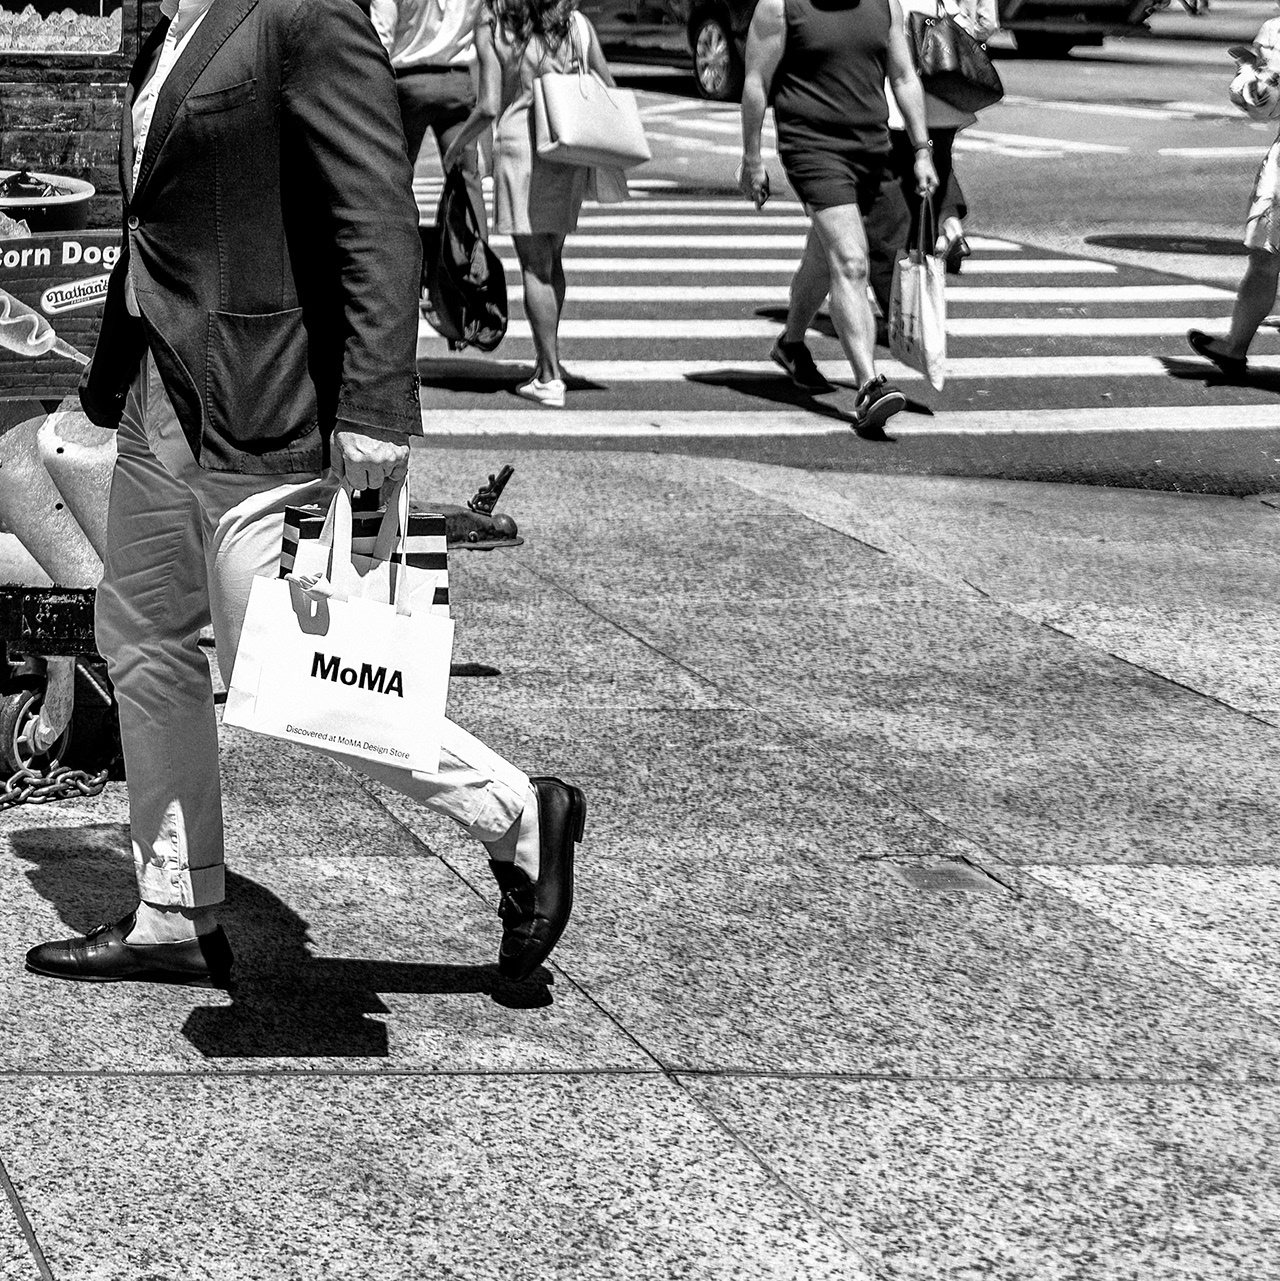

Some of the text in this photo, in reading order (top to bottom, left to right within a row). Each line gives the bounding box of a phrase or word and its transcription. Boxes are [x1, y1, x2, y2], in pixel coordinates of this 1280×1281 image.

[62, 241, 121, 269] Dog
[310, 651, 404, 698] MoMA
[285, 724, 410, 759] Discovered at MoMA Design Store
